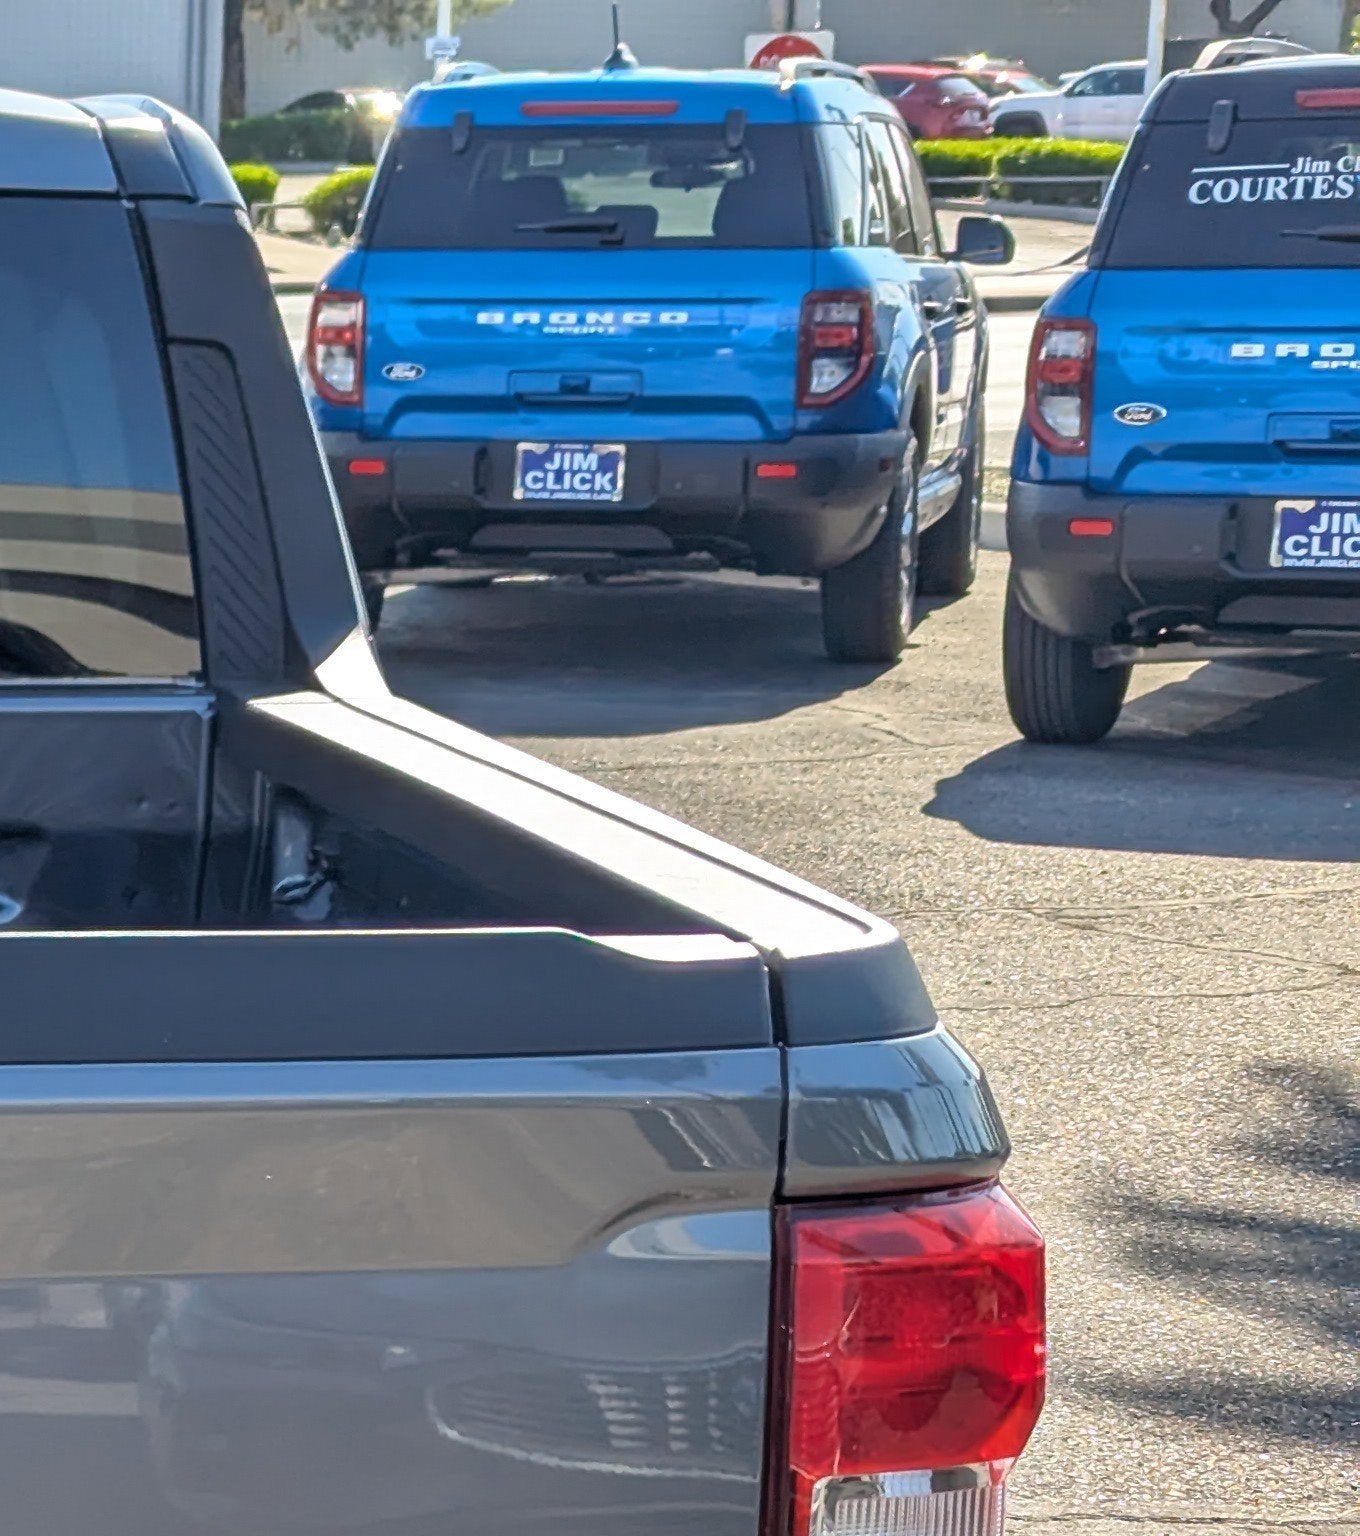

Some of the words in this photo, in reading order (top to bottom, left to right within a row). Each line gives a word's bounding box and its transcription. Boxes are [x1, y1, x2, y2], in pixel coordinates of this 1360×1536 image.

[1290, 156, 1331, 174] Jim
[477, 312, 688, 325] BRONCO
[1231, 343, 1355, 357] BRO
[544, 452, 599, 471] JIM
[524, 472, 614, 491] CLICK
